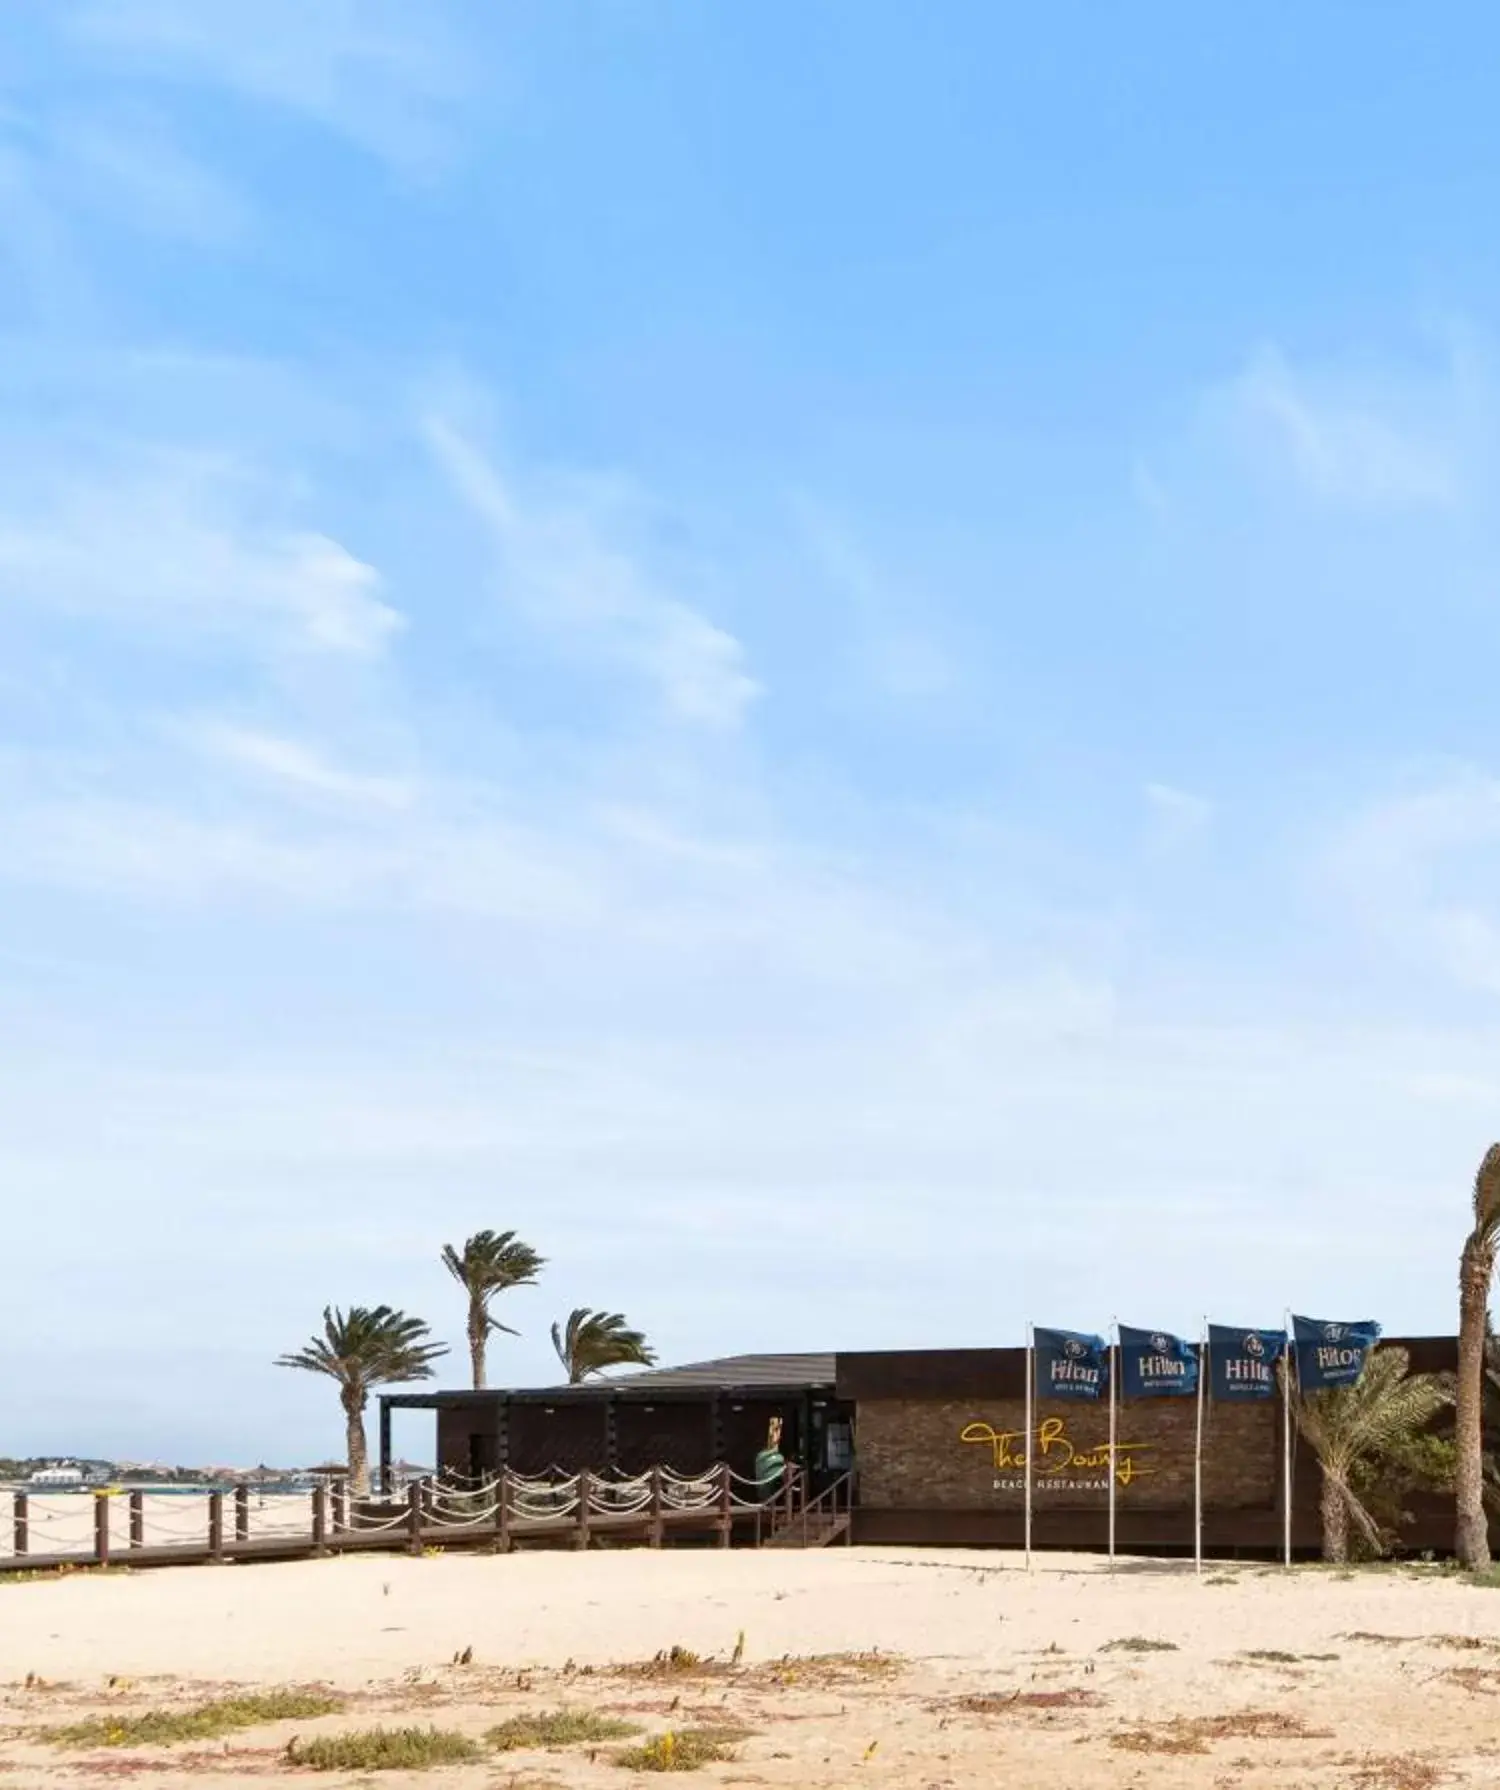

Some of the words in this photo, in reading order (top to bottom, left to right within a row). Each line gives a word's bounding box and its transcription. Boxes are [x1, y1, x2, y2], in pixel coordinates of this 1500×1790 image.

[1051, 1359, 1099, 1383] Hilton
[1225, 1359, 1270, 1381] Hilt
[960, 1423, 1027, 1468] The
[993, 1479, 1027, 1489] BEAC
[1036, 1479, 1112, 1489] RESTAURAN
